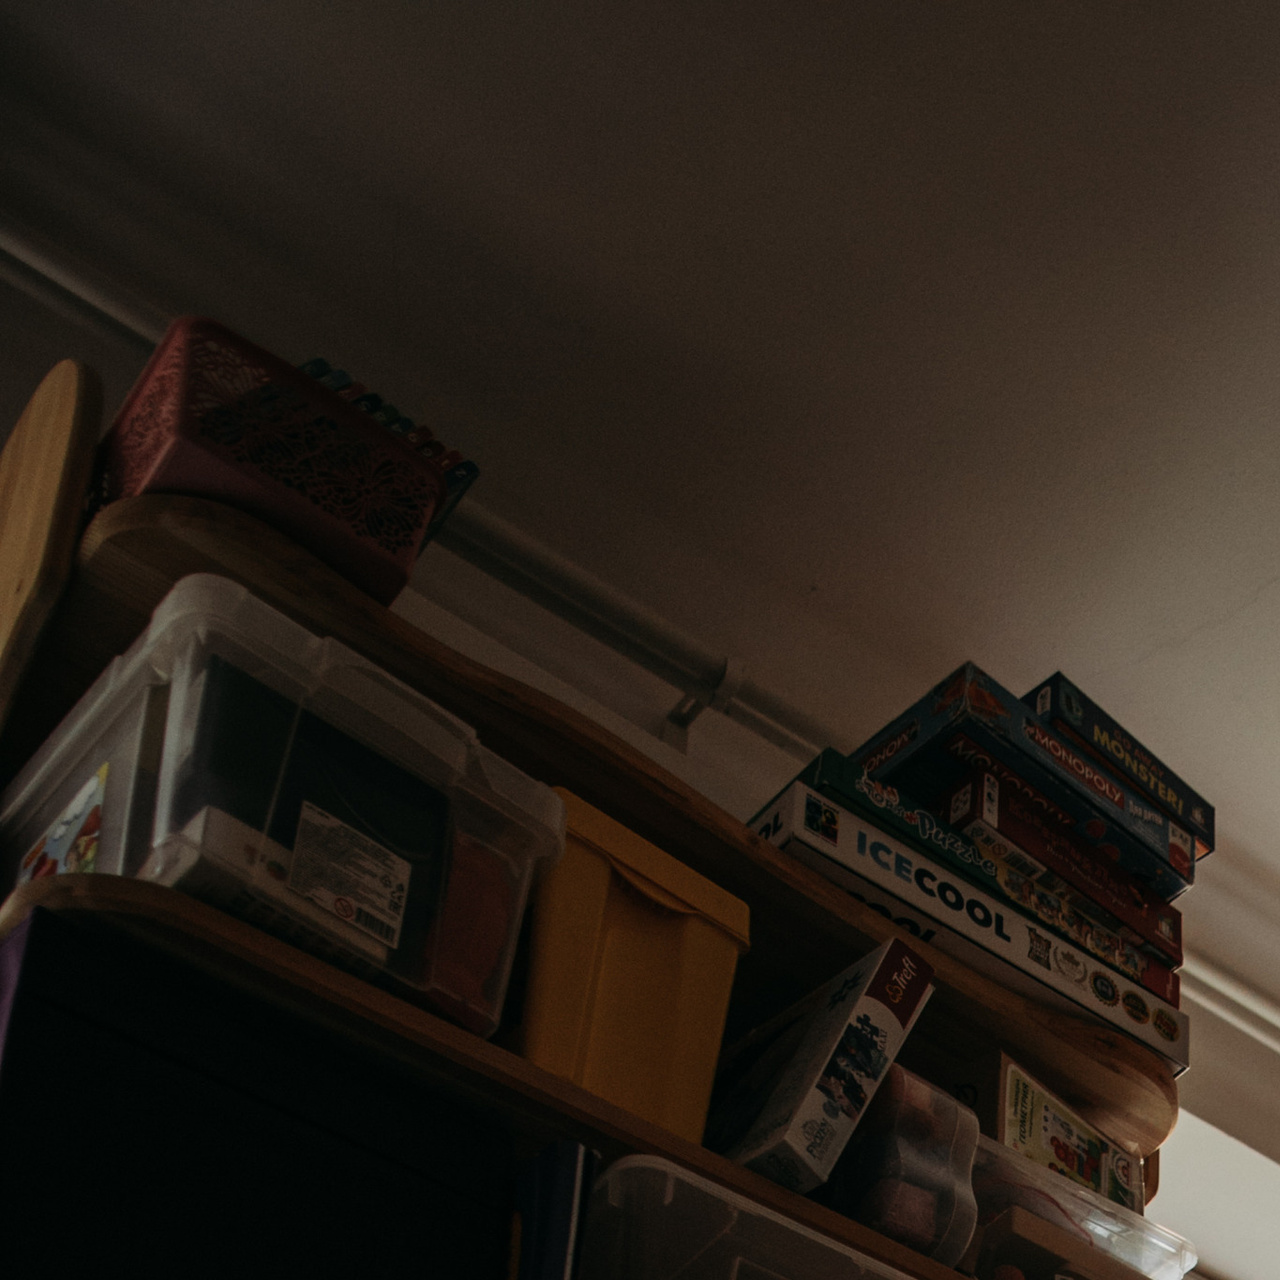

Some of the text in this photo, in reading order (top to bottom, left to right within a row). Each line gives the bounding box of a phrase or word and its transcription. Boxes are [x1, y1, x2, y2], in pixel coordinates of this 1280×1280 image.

[1035, 727, 1121, 802] MONOPOLY
[857, 830, 1011, 942] ICECOOL
[1018, 1082, 1030, 1145] ГЕОМЕТРИЯ
